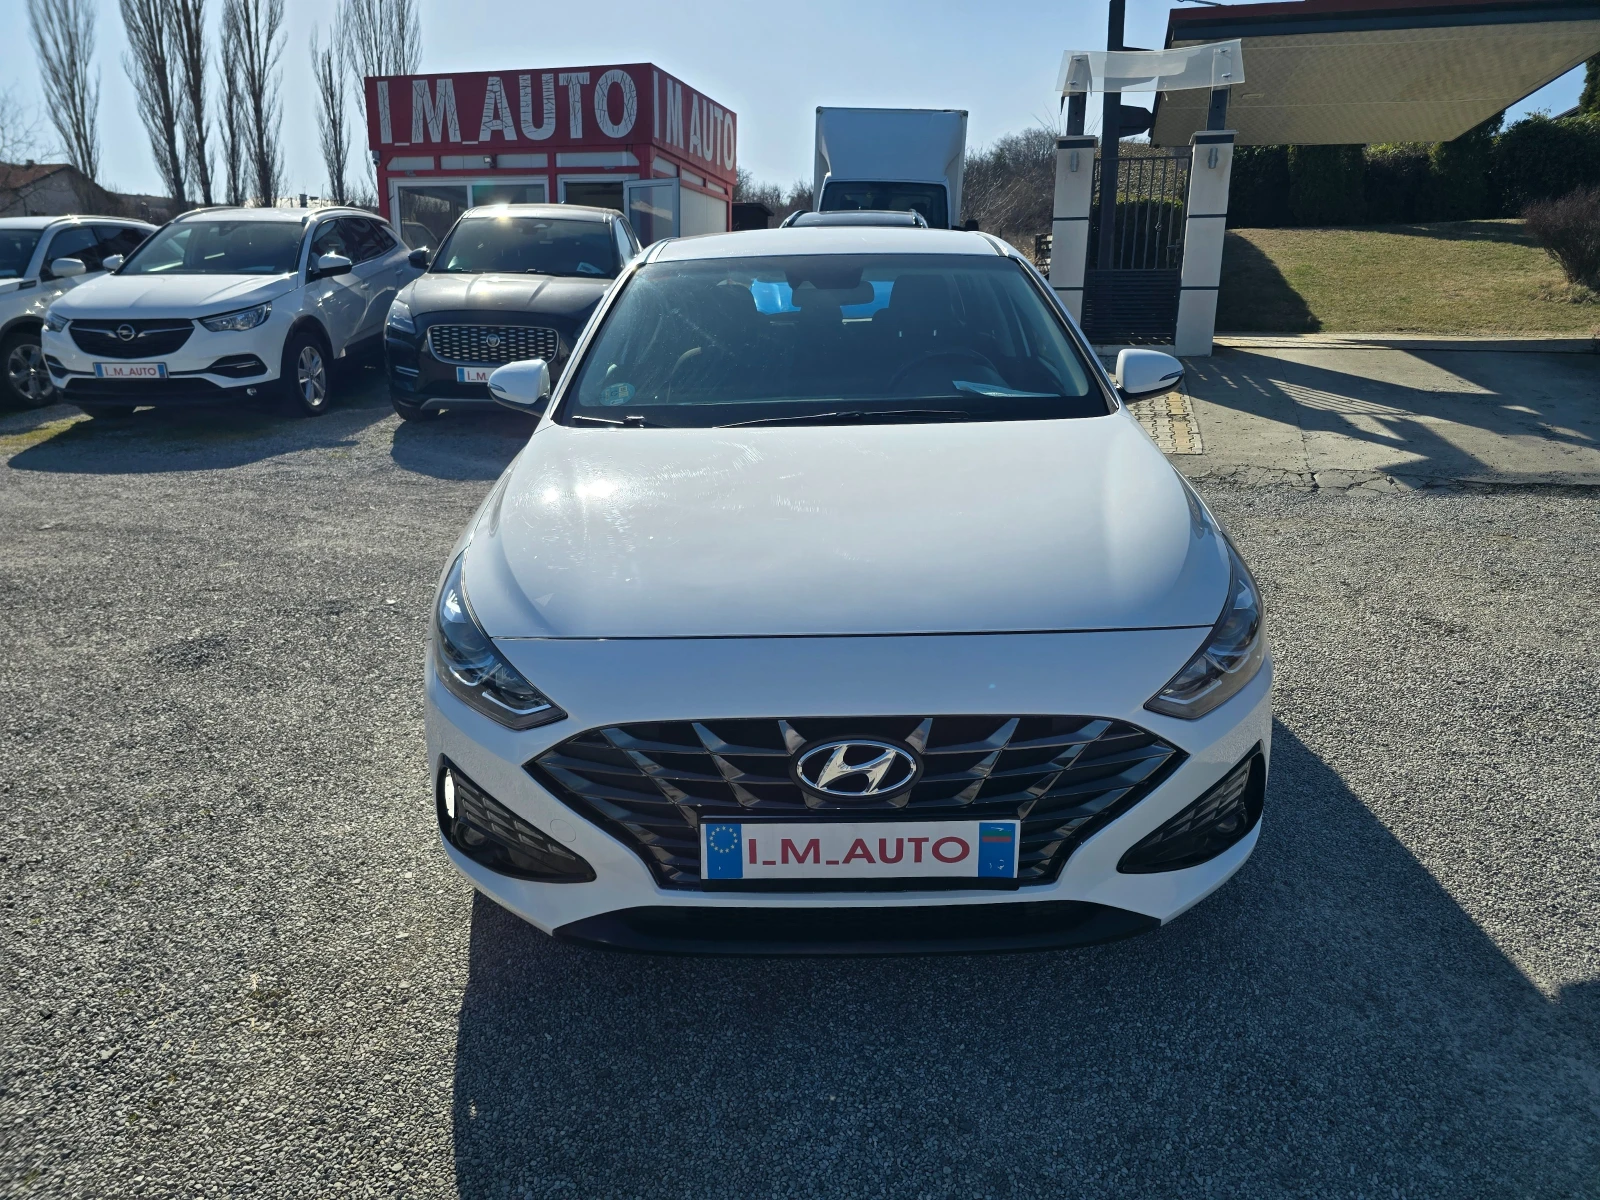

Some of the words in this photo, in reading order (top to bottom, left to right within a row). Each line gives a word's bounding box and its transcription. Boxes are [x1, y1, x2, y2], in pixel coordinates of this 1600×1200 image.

[653, 70, 660, 140] I
[666, 78, 684, 149] M
[689, 93, 735, 171] AUTO
[104, 366, 157, 376] I_M_AUTO
[748, 836, 971, 866] I_M_AUTO
